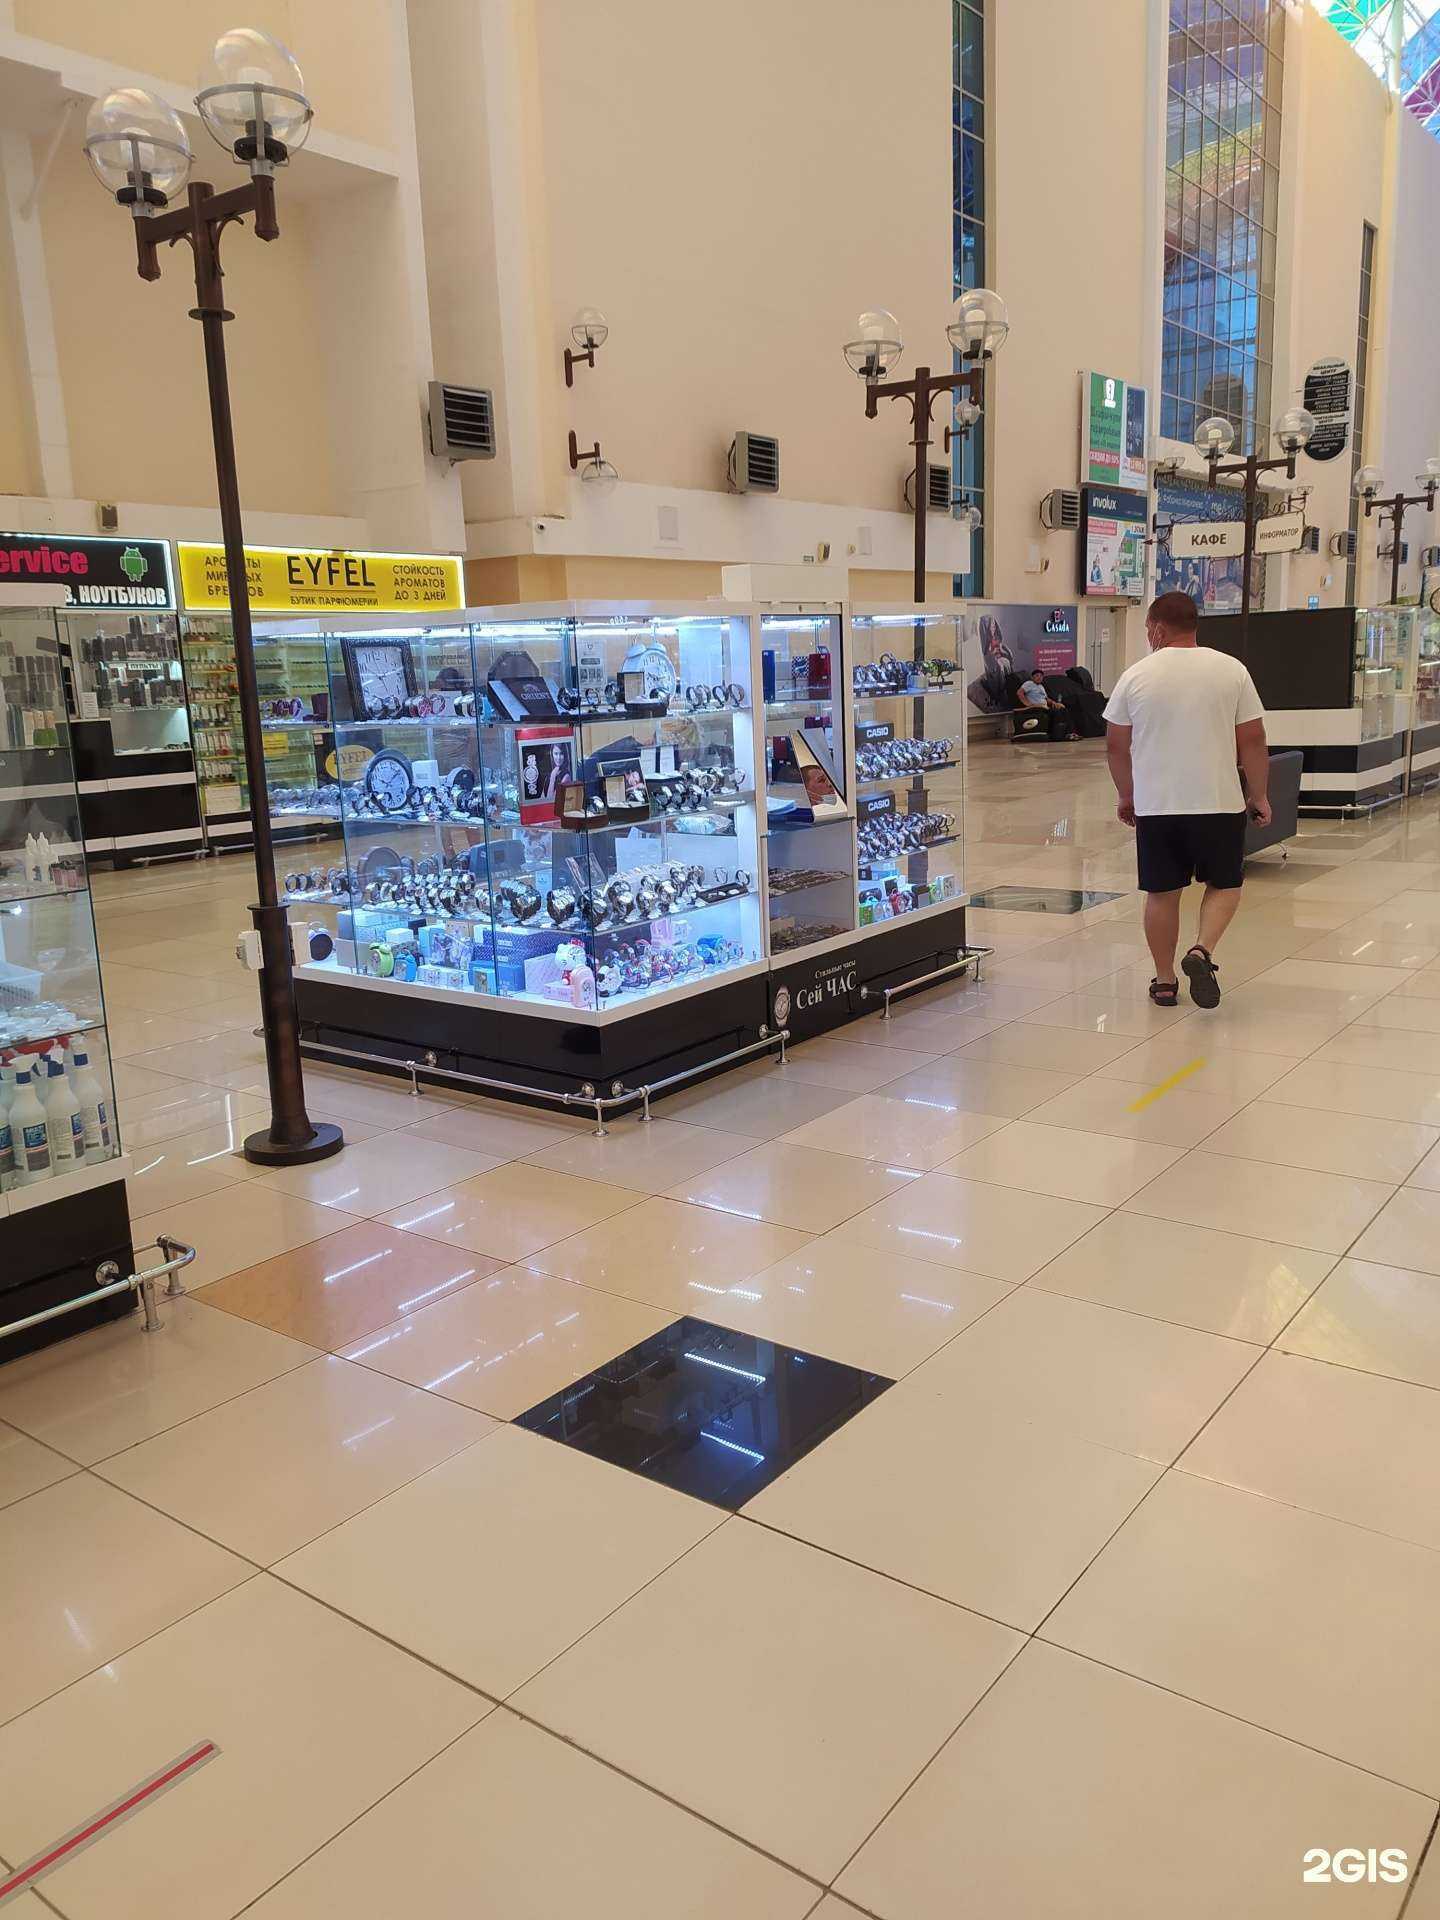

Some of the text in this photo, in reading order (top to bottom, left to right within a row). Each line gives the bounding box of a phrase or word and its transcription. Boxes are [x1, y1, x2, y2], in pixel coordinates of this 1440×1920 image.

[1092, 494, 1117, 511] involux
[1191, 533, 1227, 546] КАФЕ
[1259, 527, 1299, 540] ИНФОРМАТОР
[205, 556, 262, 569] АРОТЫ
[286, 555, 376, 587] EYFEL
[392, 563, 445, 576] СТОЙКОСТЬ
[393, 577, 446, 588] АРОМАТОВ
[79, 585, 167, 605] НОУТБУКОВ
[207, 585, 265, 597] БРЕОВ
[394, 589, 447, 601] ДО 3 ДНЕЙ
[290, 596, 379, 607] БУТИК ПАРФЮМЕРИИ
[866, 726, 889, 738] CASIO
[868, 798, 890, 811] CASIO
[796, 971, 857, 1010] Сей ЧАС
